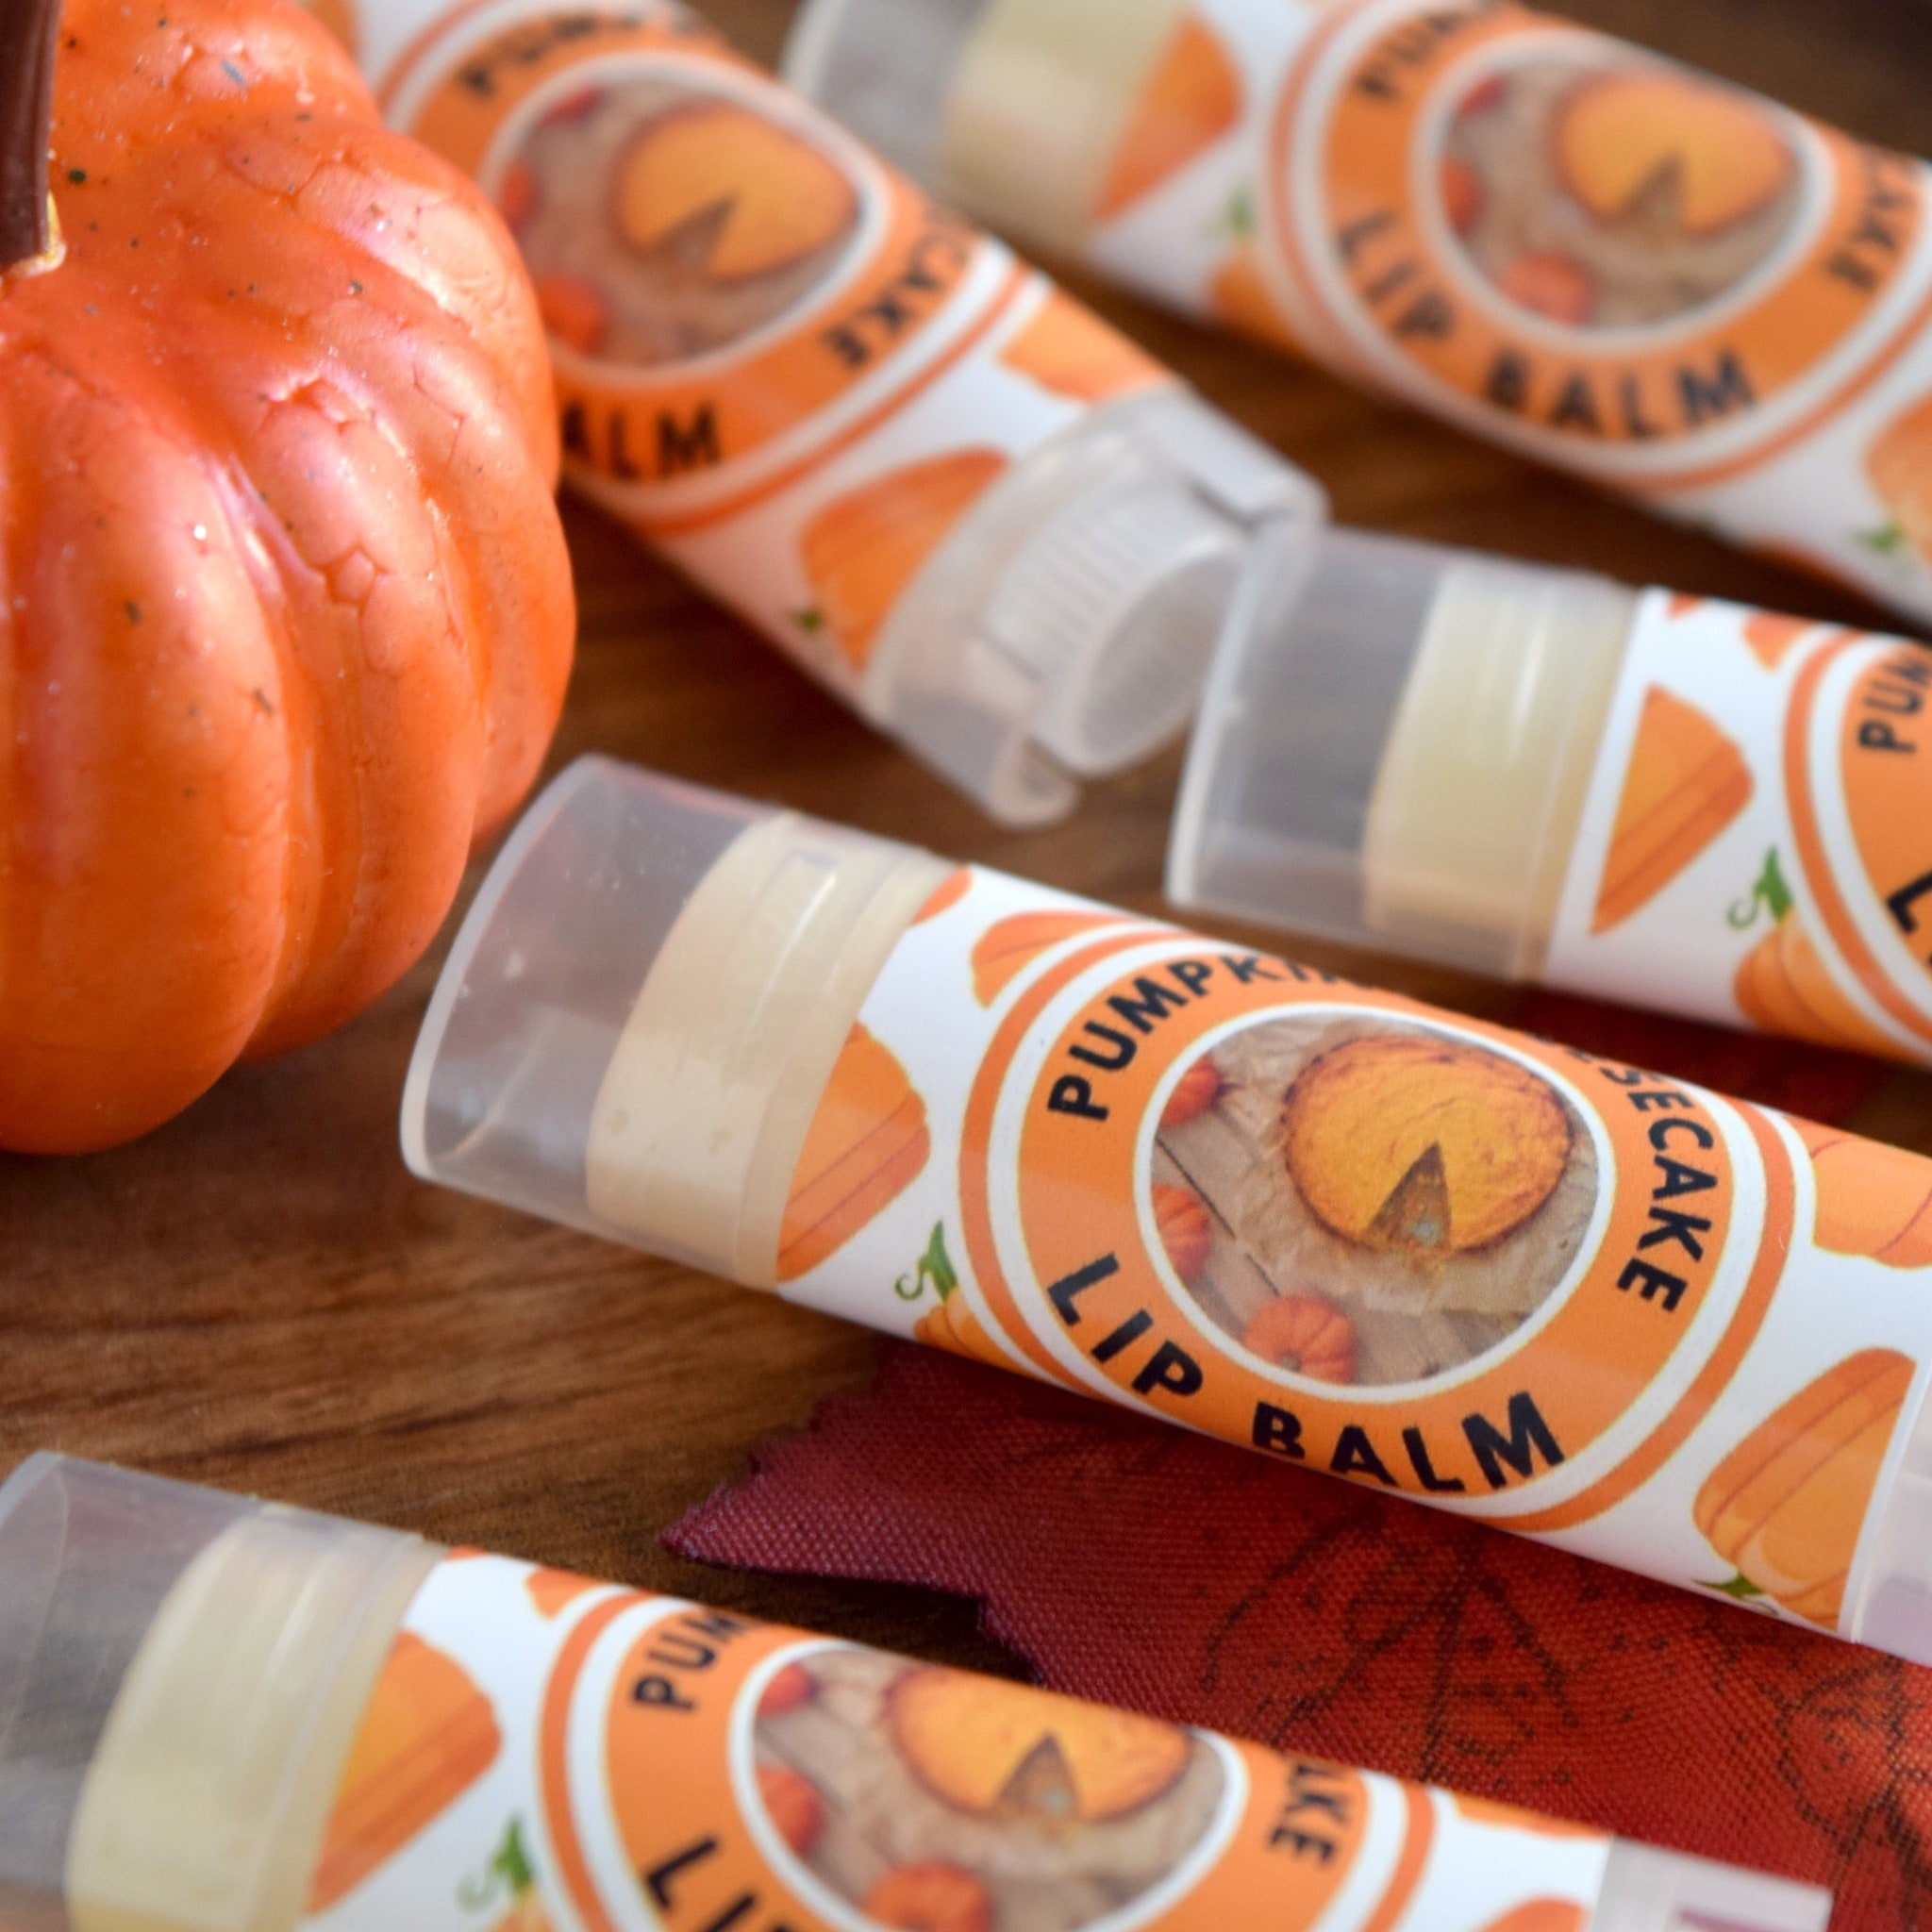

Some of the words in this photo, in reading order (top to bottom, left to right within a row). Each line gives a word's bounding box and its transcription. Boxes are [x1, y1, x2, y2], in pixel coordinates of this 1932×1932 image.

[561, 396, 721, 479] ALM
[1485, 344, 1759, 443] BALM
[1047, 1252, 1204, 1397] LIP
[1251, 1391, 1566, 1491] BALM
[647, 1839, 797, 1932] LI
